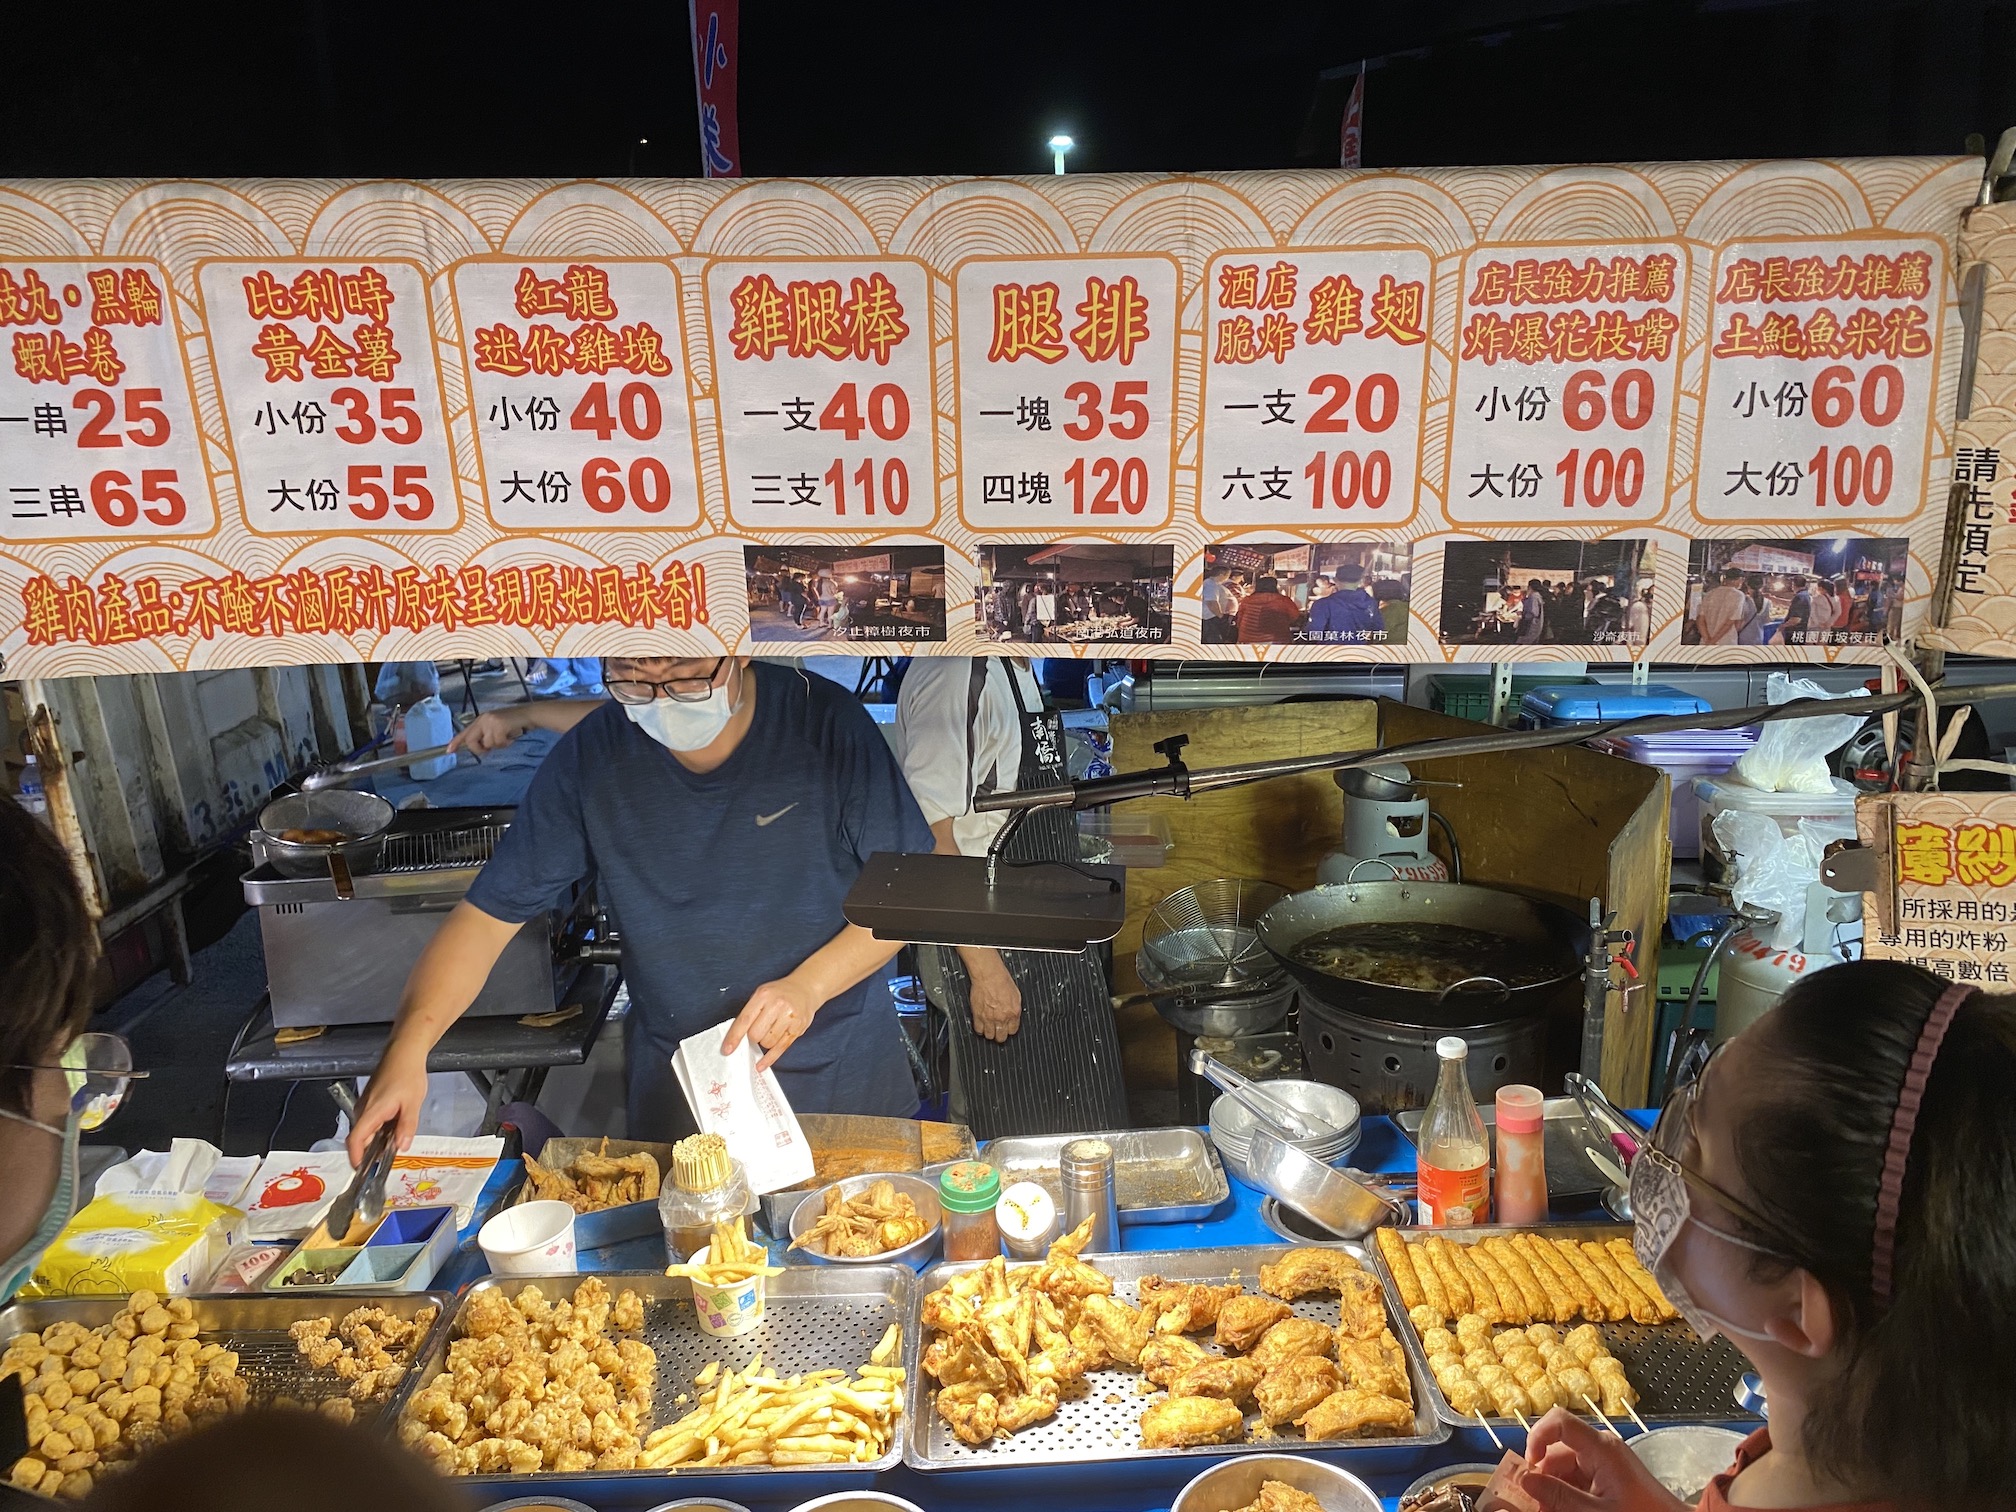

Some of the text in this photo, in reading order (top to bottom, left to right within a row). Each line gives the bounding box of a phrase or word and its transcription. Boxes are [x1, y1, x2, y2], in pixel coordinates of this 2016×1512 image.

[242, 266, 395, 324] 比利時
[515, 264, 618, 321] 紅龍
[1218, 260, 1298, 312] 酒店
[1468, 252, 1677, 306] 店長強力推薦
[1716, 251, 1932, 304] 店長強力推薦
[728, 272, 910, 366] 雞腿棒
[988, 275, 1149, 366] 腿排
[1303, 272, 1427, 347] 雞翅
[1461, 308, 1680, 366] 炸爆花枝嘴
[1712, 305, 1934, 361] 土魠魚米花
[13, 326, 126, 386] 蝦仁卷
[252, 323, 402, 383] 黃金薯
[474, 321, 673, 378] 迷你雞塊
[1214, 313, 1299, 365] 脆炸
[0, 388, 171, 448] 一串 25
[254, 387, 423, 445] 小份 35
[488, 382, 663, 441] 小份 40
[742, 382, 911, 441] 一支 40
[979, 380, 1150, 442] 一塊 35
[1223, 373, 1400, 434] 一支 20
[1475, 368, 1656, 433] 小份 60
[1732, 363, 1905, 428] 小份 60
[8, 469, 187, 527] 三串 65
[267, 464, 435, 521] 大份 55
[500, 457, 671, 514] 大份 60
[750, 458, 909, 516] 三支 110
[982, 456, 1148, 515] 四塊 120
[1222, 449, 1392, 511] 六支 100
[1468, 445, 1645, 509] 大份 100
[1723, 444, 1894, 507] 大份 100
[832, 625, 931, 638] 汐止樟樹夜市
[1293, 630, 1389, 641] 大園菓林夜市
[1790, 630, 1878, 644] 桃園新坡夜市
[1902, 898, 2016, 922] 所採用的
[240, 1252, 271, 1271] 100
